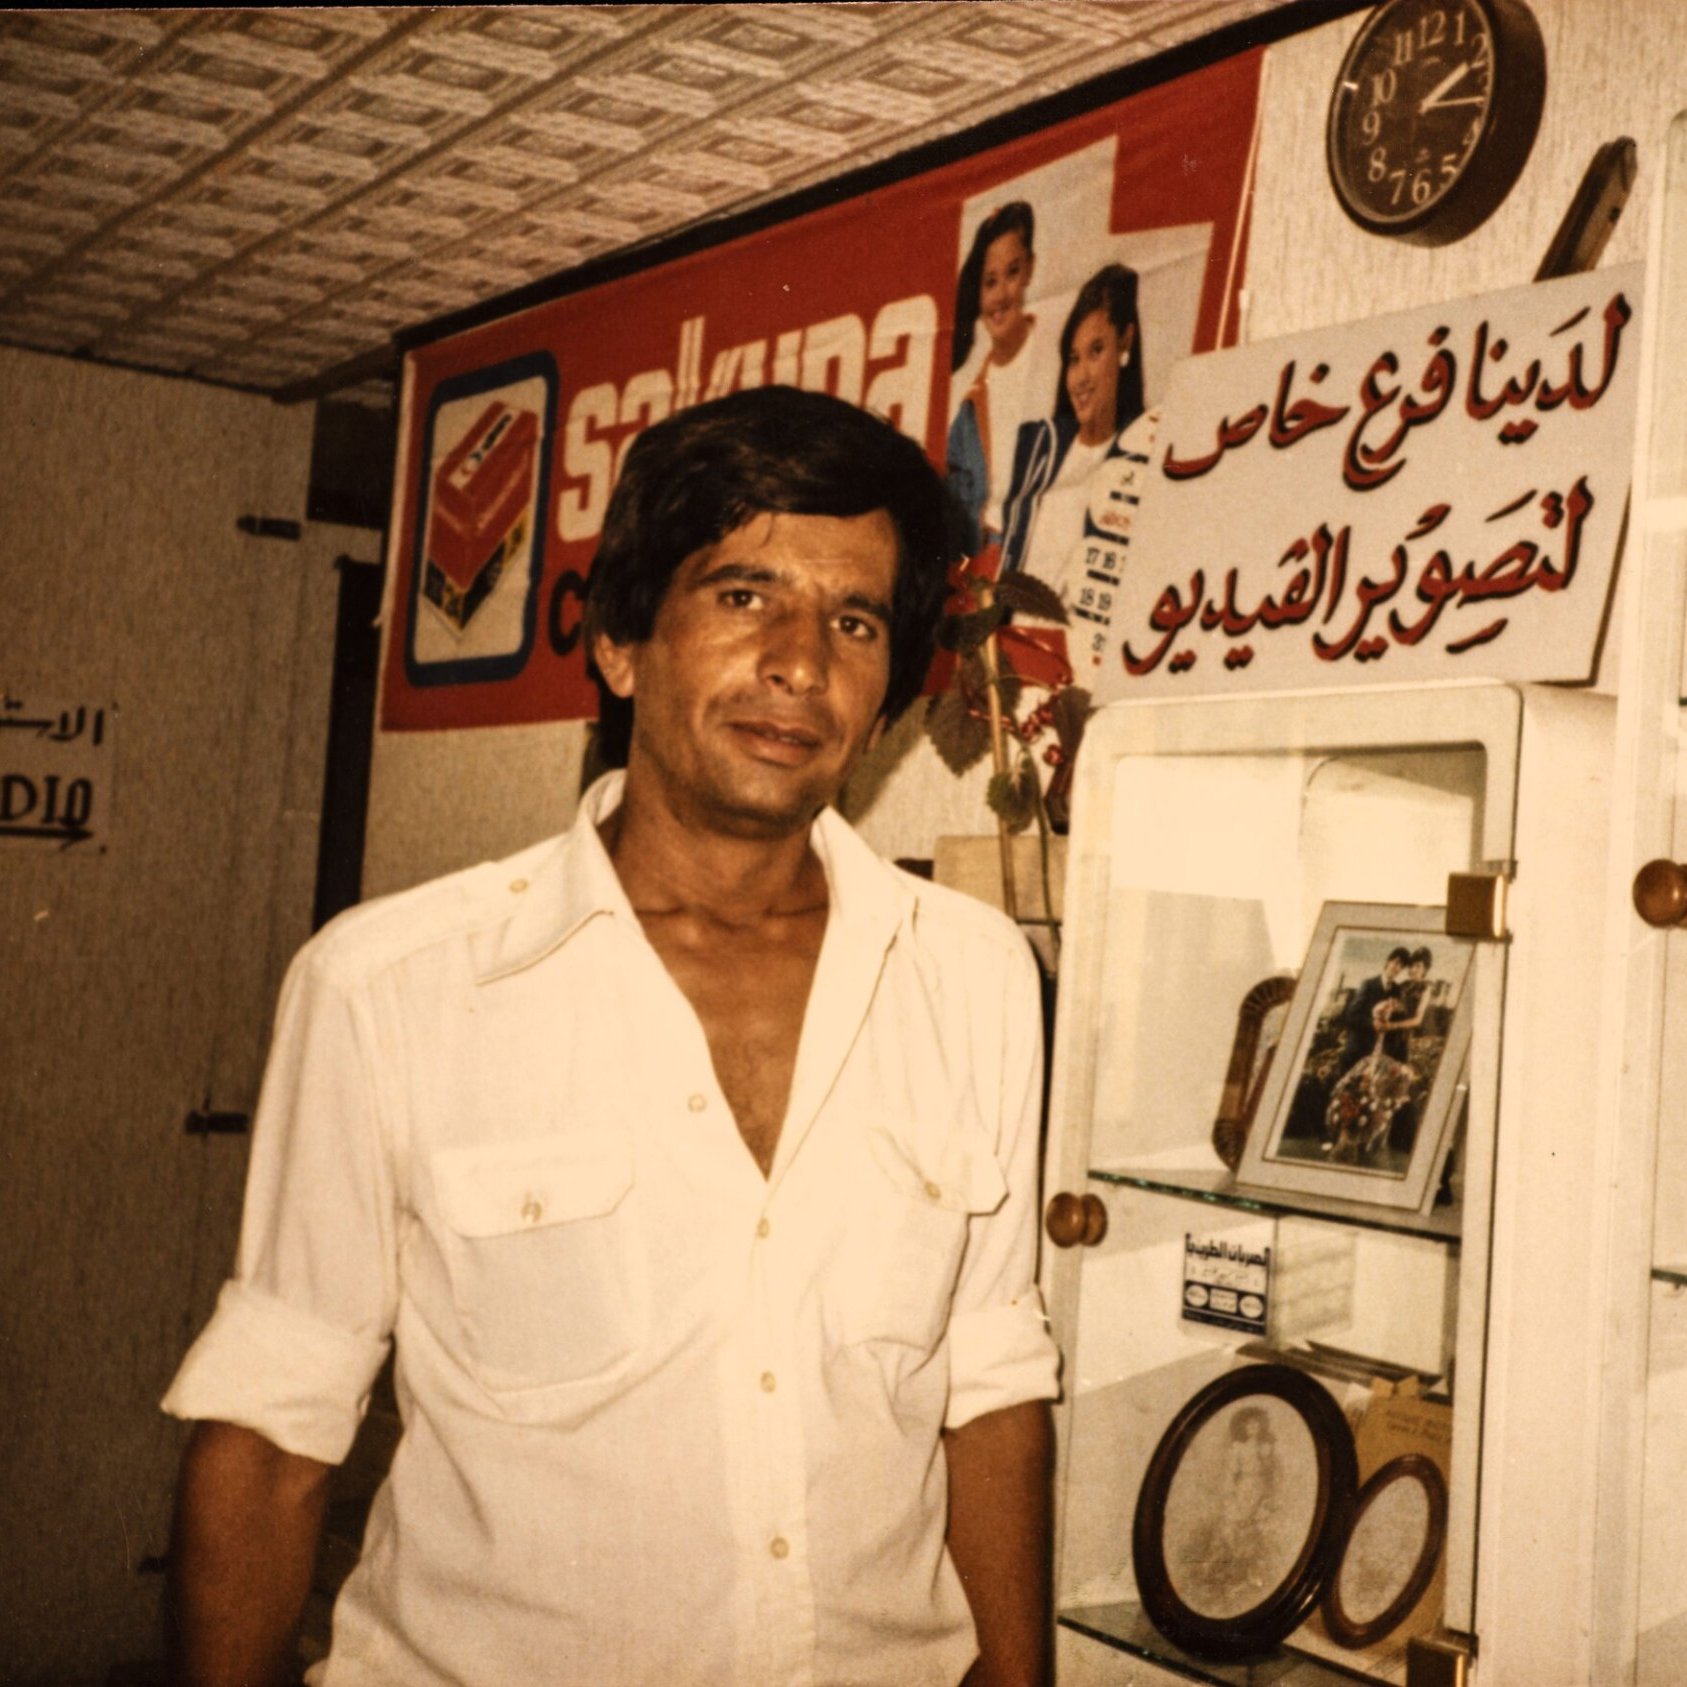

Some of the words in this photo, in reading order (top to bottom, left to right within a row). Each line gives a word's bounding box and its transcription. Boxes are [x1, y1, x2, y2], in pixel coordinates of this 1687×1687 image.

[1419, 11, 1447, 49] 12
[1454, 11, 1466, 47] 1
[1393, 30, 1414, 66] 11
[1470, 33, 1487, 69] 2
[1372, 68, 1397, 107] 10
[1361, 109, 1381, 146] 9
[1368, 147, 1387, 183] 8
[1439, 153, 1459, 191] 5
[1388, 169, 1406, 206] 7
[1411, 167, 1431, 204] 6
[1466, 292, 1632, 445] لدينا
[1162, 360, 1351, 481] خاص
[1342, 326, 1457, 491] فرع
